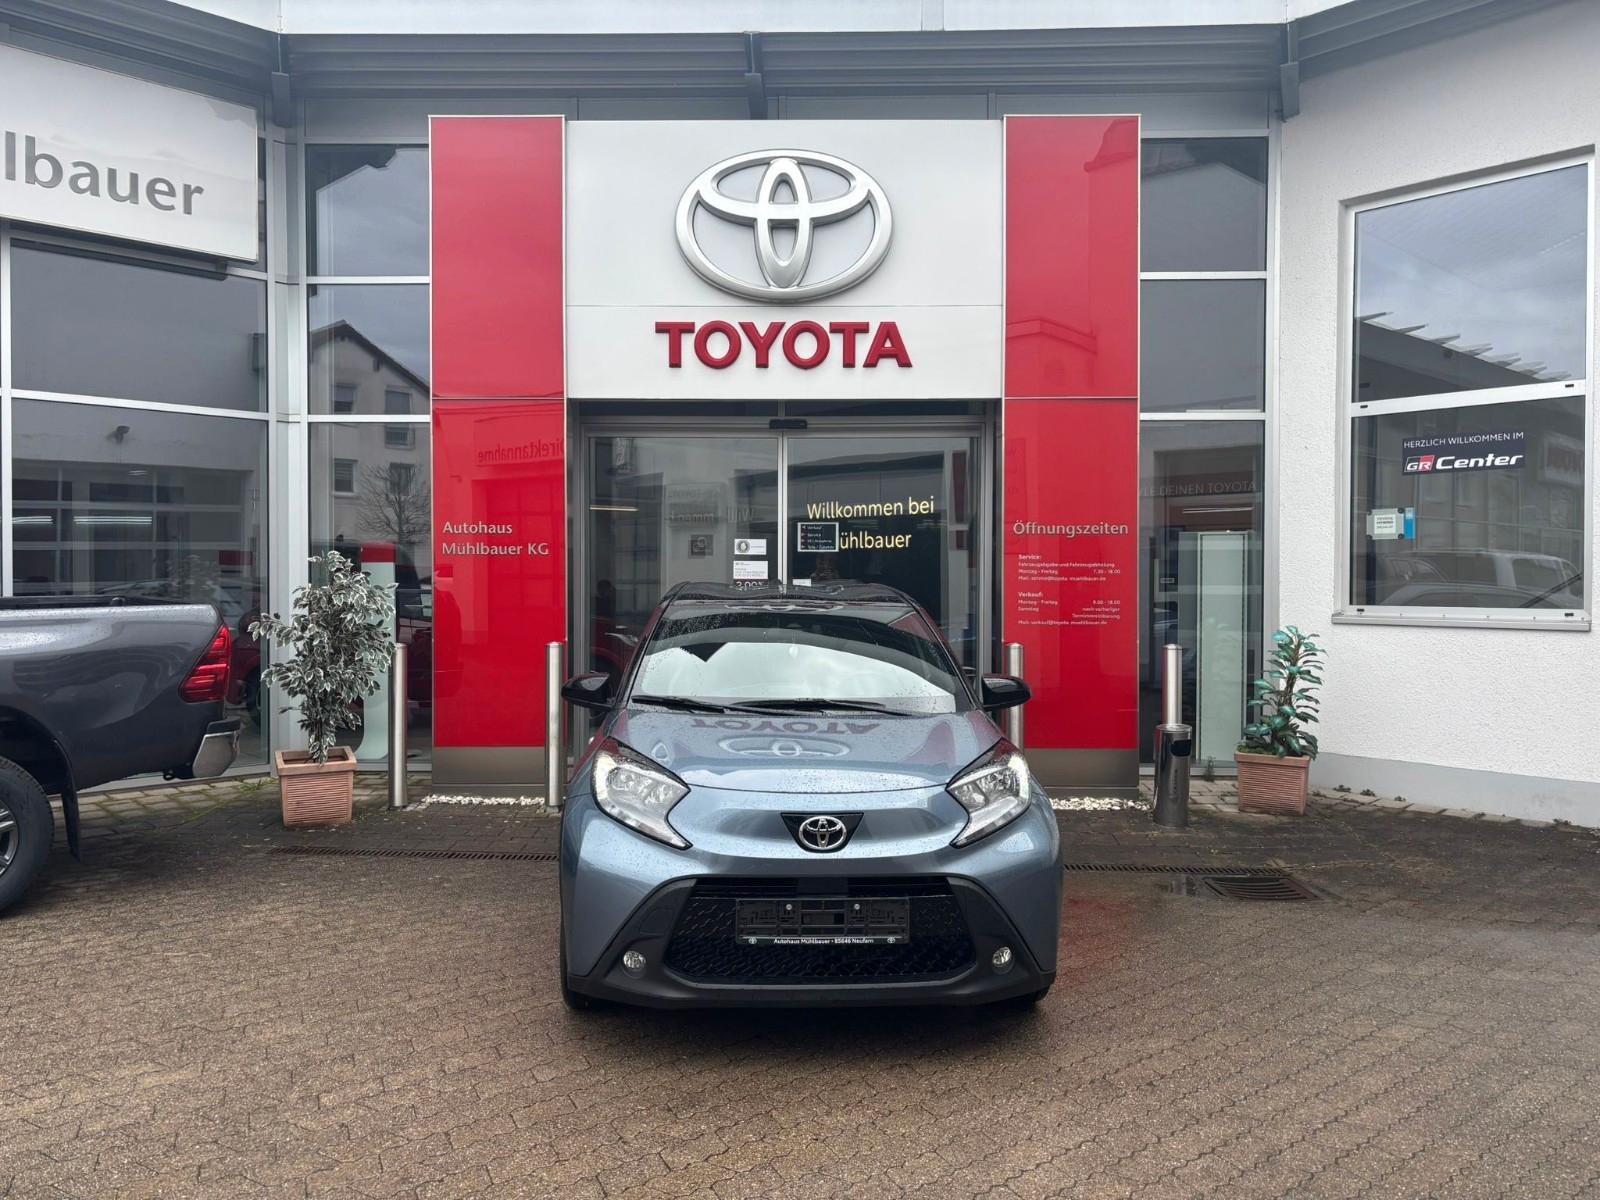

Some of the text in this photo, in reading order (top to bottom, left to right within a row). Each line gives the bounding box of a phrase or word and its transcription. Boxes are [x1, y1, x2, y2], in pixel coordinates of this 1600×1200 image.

[655, 320, 913, 370] TOYOTA
[1404, 431, 1524, 448] HERZLICH WILLKOMMEN IM
[1406, 453, 1524, 471] GR Center
[1207, 480, 1256, 494] TOYOTA
[806, 495, 934, 520] Willkommen bei
[442, 521, 513, 534] Autohaus
[1013, 520, 1128, 538] Öffnungszeiten
[442, 542, 549, 555] Mühlbauer KG
[840, 530, 912, 549] ühlbauer
